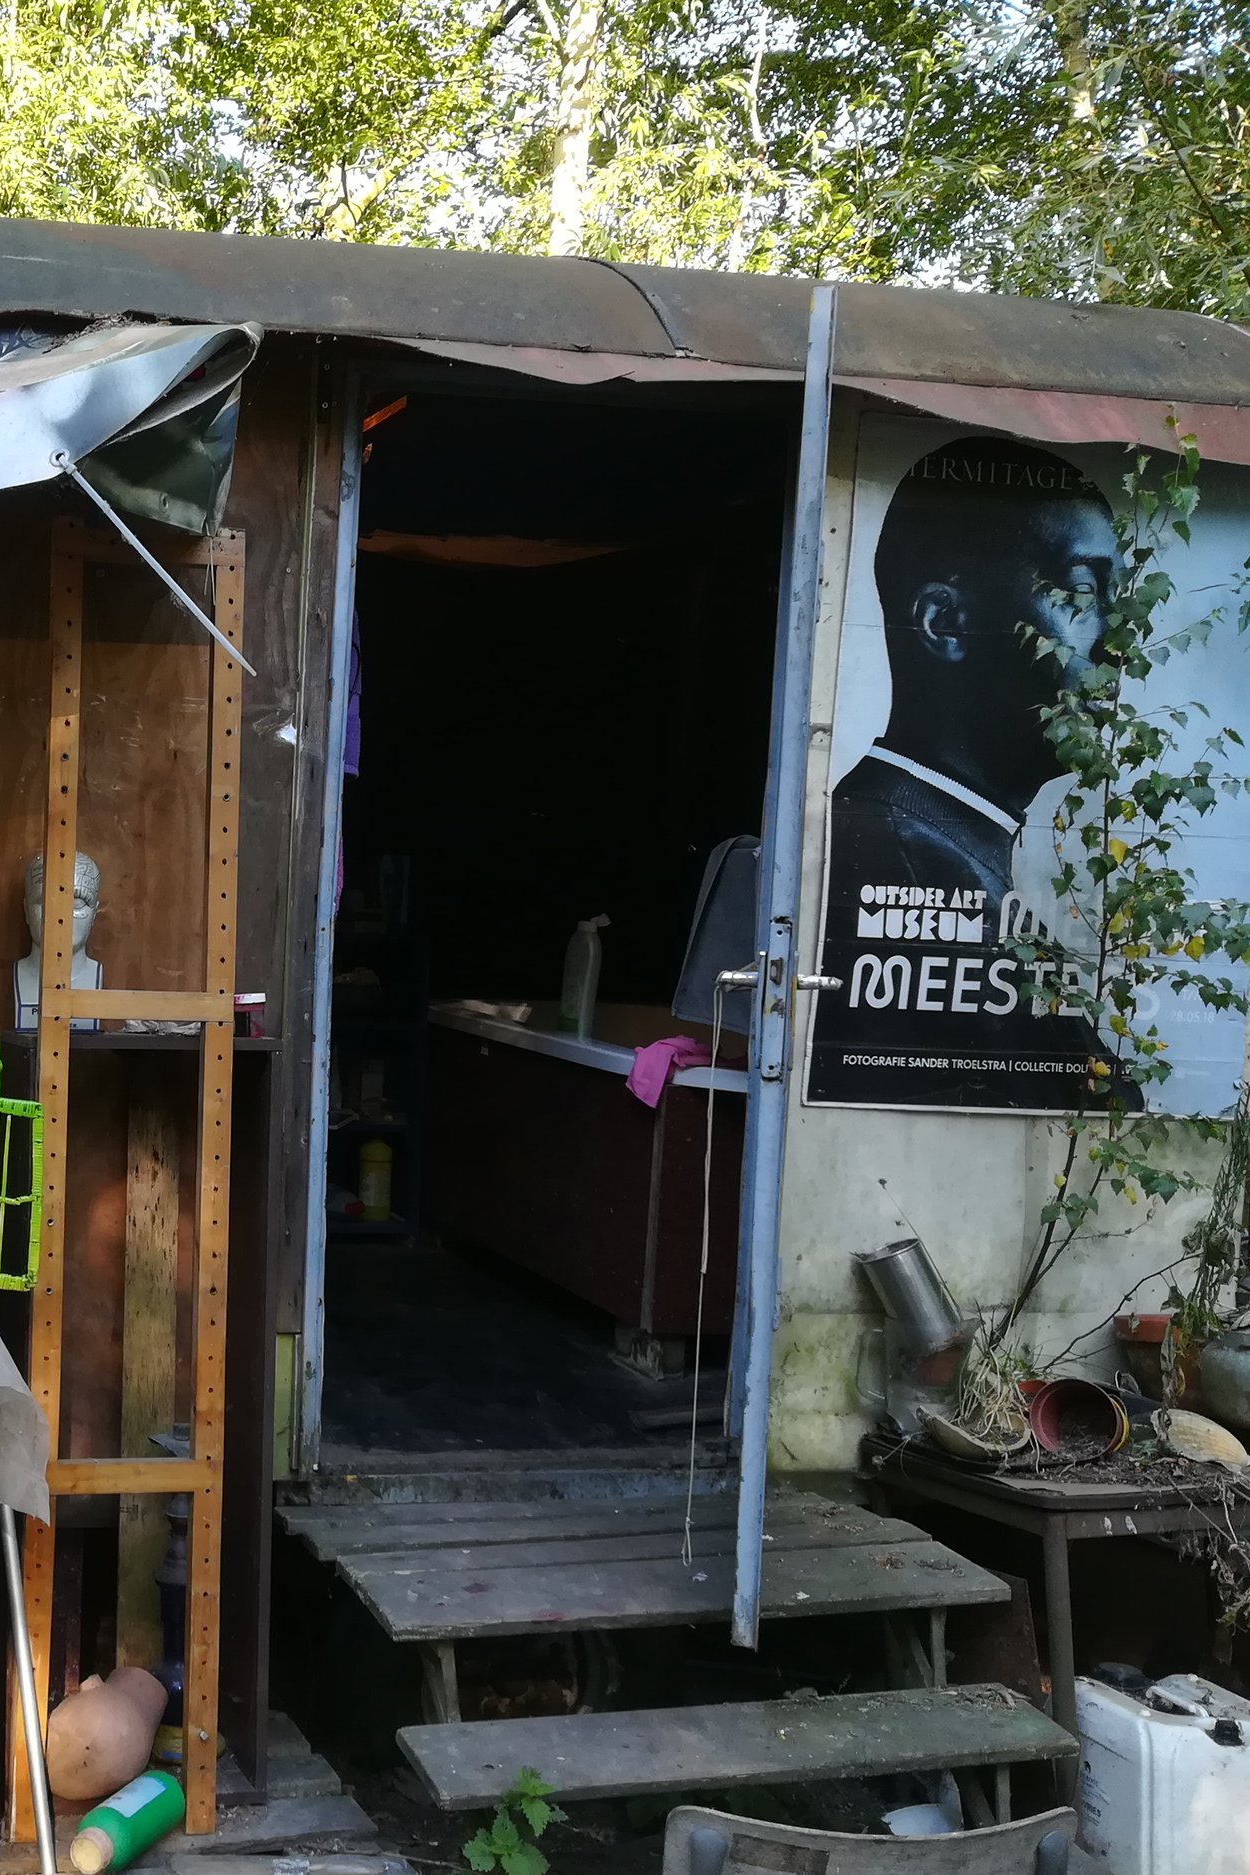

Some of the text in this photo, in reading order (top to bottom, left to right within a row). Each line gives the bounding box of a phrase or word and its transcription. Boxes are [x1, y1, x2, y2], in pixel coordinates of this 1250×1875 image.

[860, 884, 987, 910] OUTSIDER ART
[856, 906, 984, 943] MUSEUM
[848, 953, 1161, 1022] MEESTE
[842, 1054, 906, 1067] FOTOGRAFIE
[907, 1057, 949, 1069] SANDER
[951, 1058, 1007, 1071] TROELSTRA
[1014, 1061, 1064, 1073] COLLECTIE
